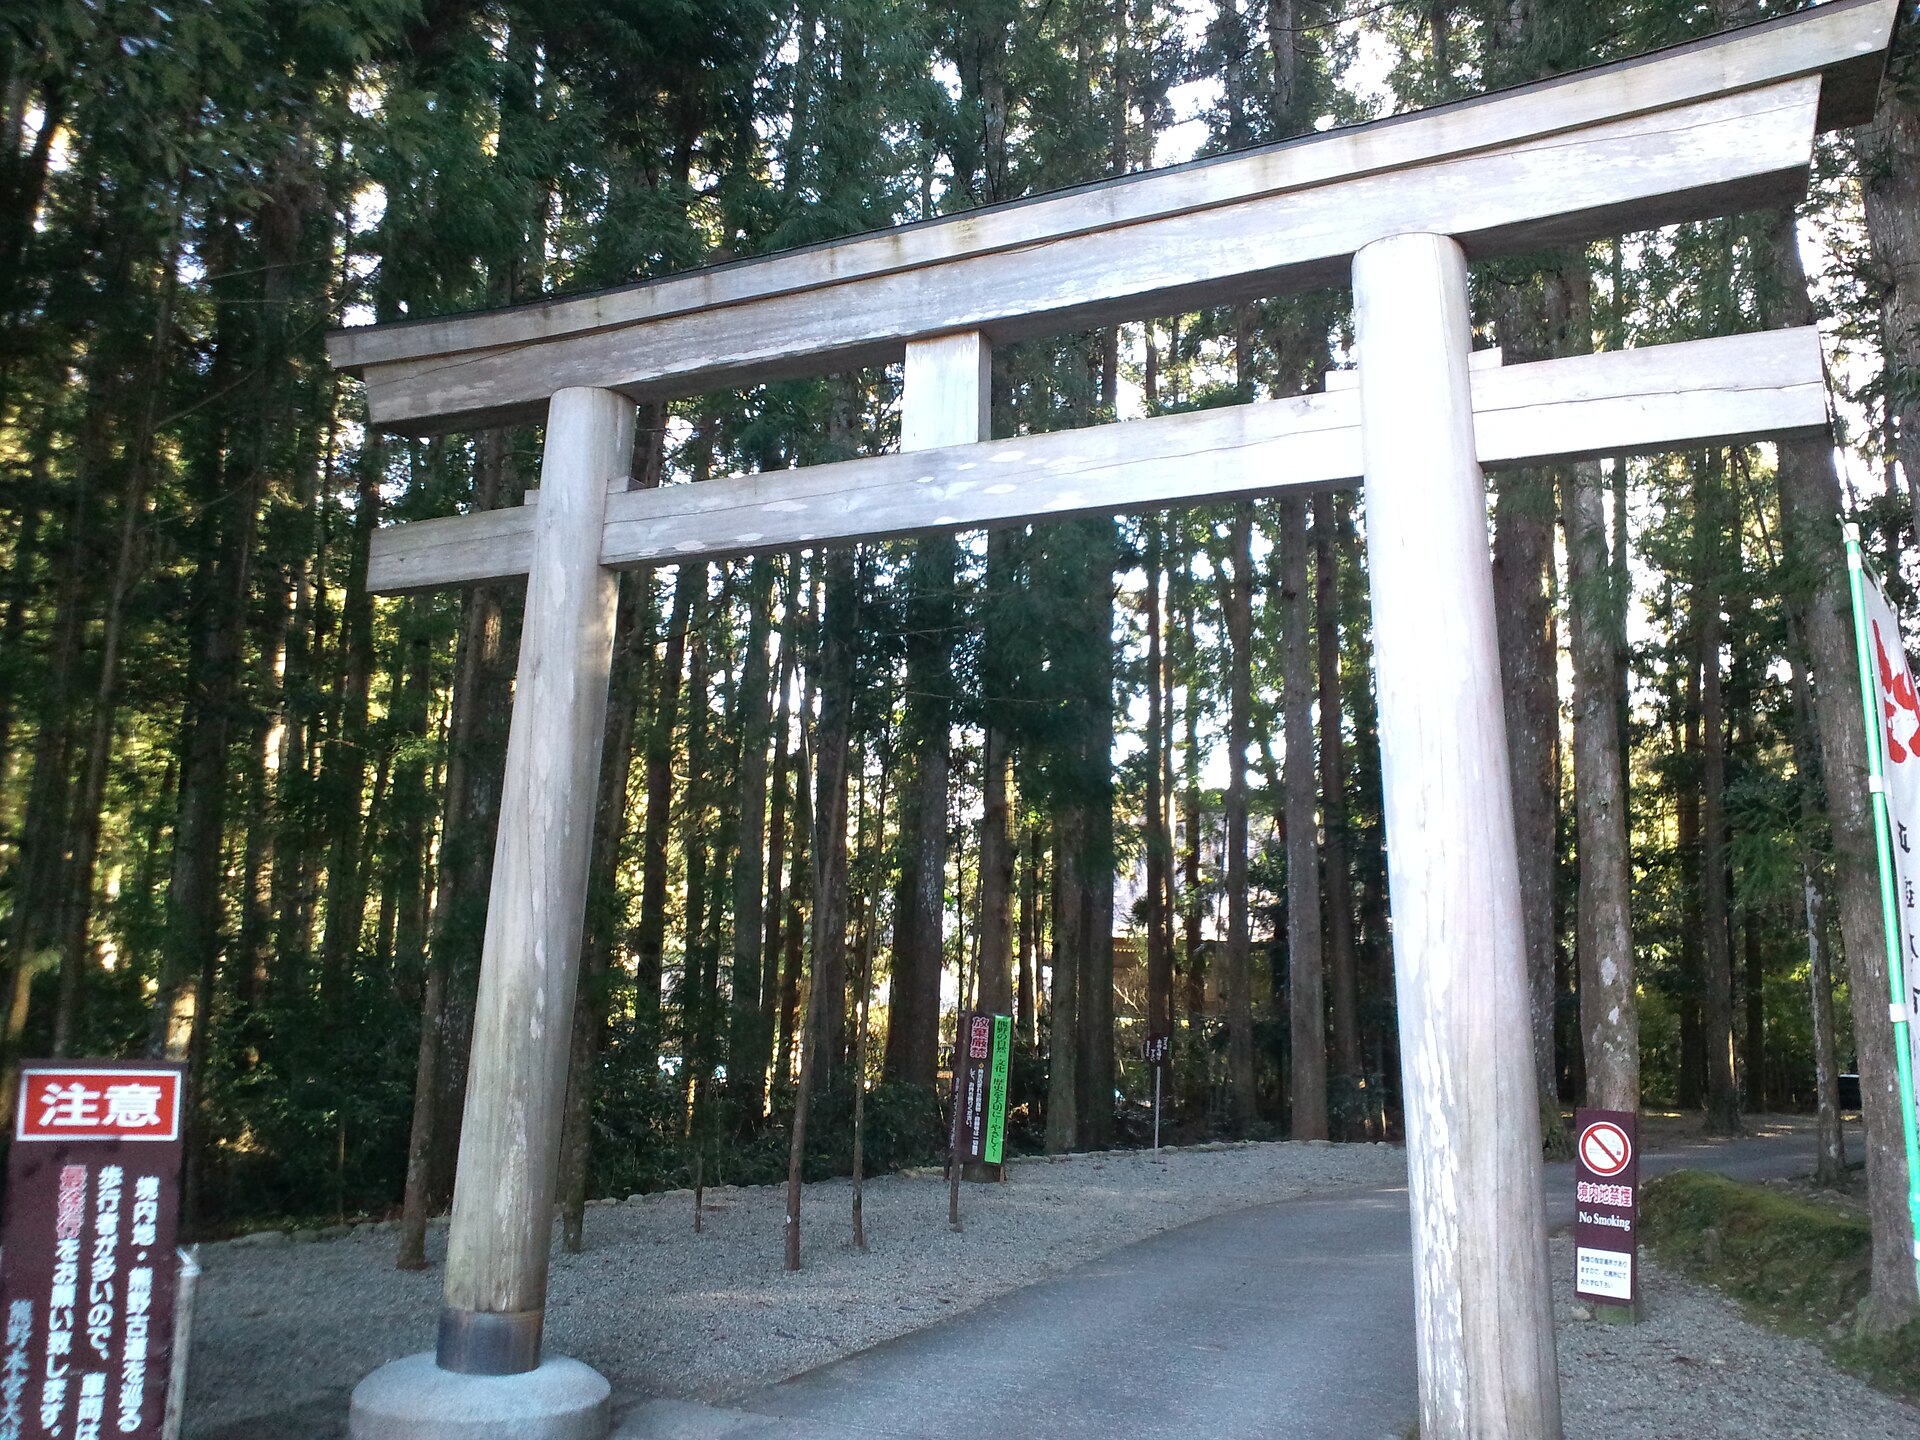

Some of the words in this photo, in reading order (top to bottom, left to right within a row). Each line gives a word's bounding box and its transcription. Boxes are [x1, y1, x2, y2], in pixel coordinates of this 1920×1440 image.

[970, 1017, 989, 1058] 放棄厳禁
[38, 1082, 162, 1127] 注意
[1577, 1181, 1633, 1208] 境内地禁煙
[1579, 1211, 1592, 1224] No
[1593, 1213, 1631, 1231] Smoking
